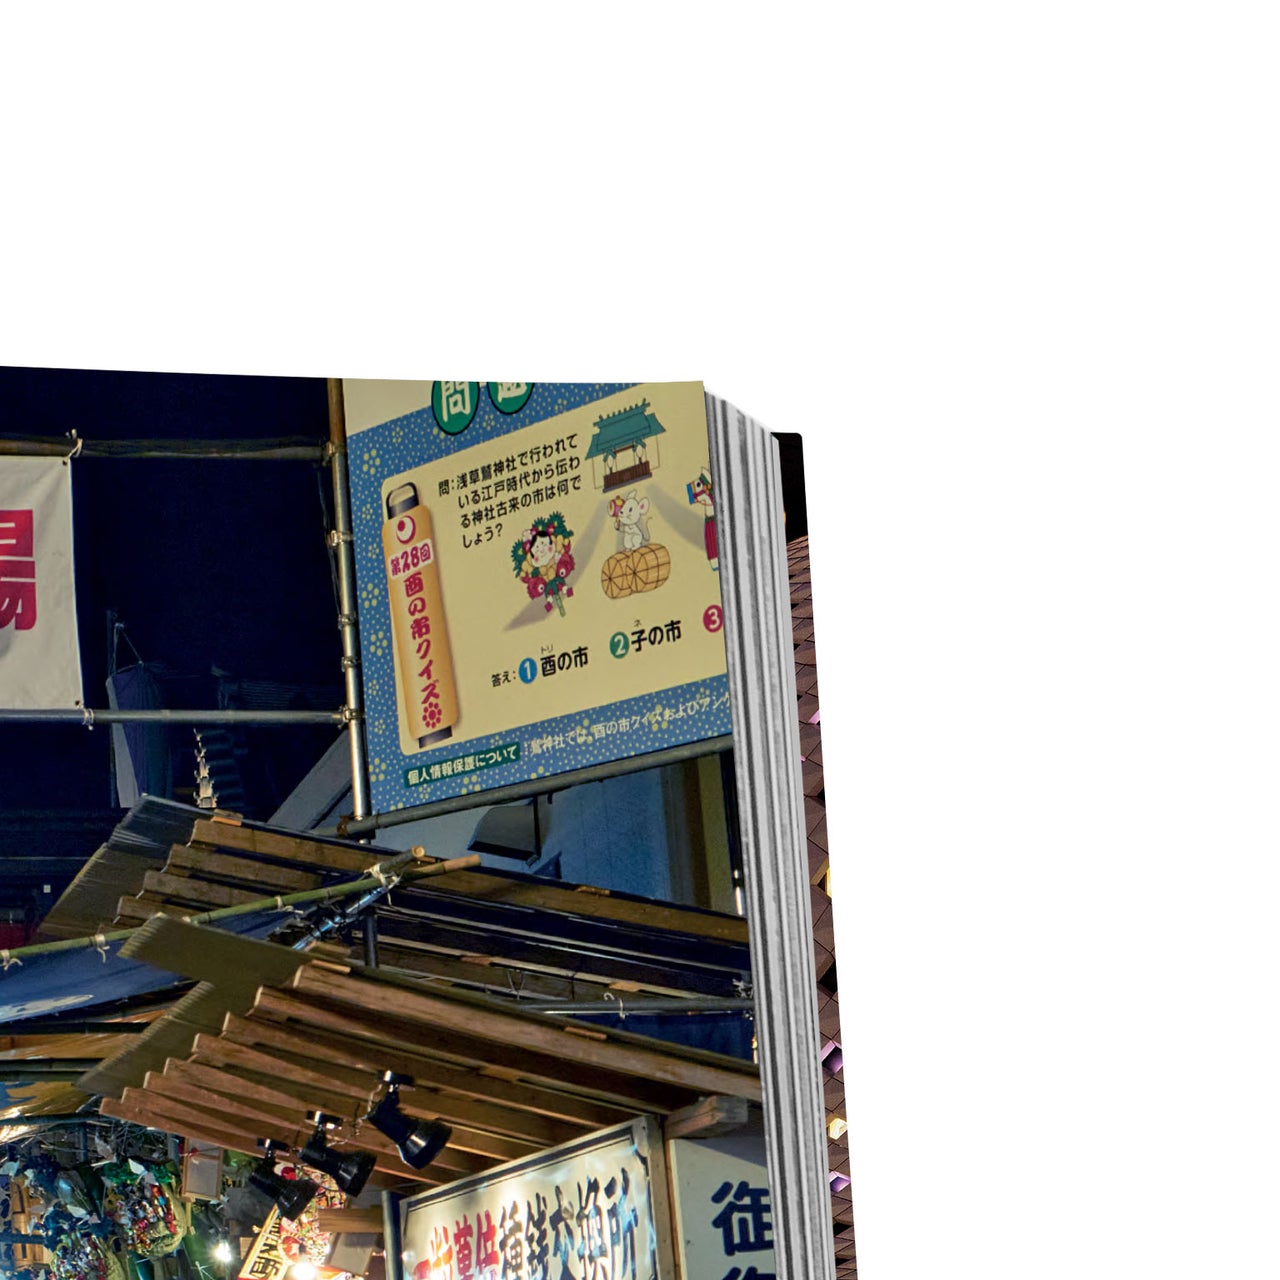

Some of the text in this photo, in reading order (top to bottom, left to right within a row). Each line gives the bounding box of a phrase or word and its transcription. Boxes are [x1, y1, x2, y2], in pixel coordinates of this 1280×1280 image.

[458, 456, 581, 509] いる江戸時代から伝わ
[460, 475, 582, 529] る神社古来の市は何で
[403, 571, 441, 705] 酉の市クイズ
[631, 620, 682, 652] 子の市
[540, 646, 589, 678] 酉の市
[407, 744, 518, 786] 個人情報保護について
